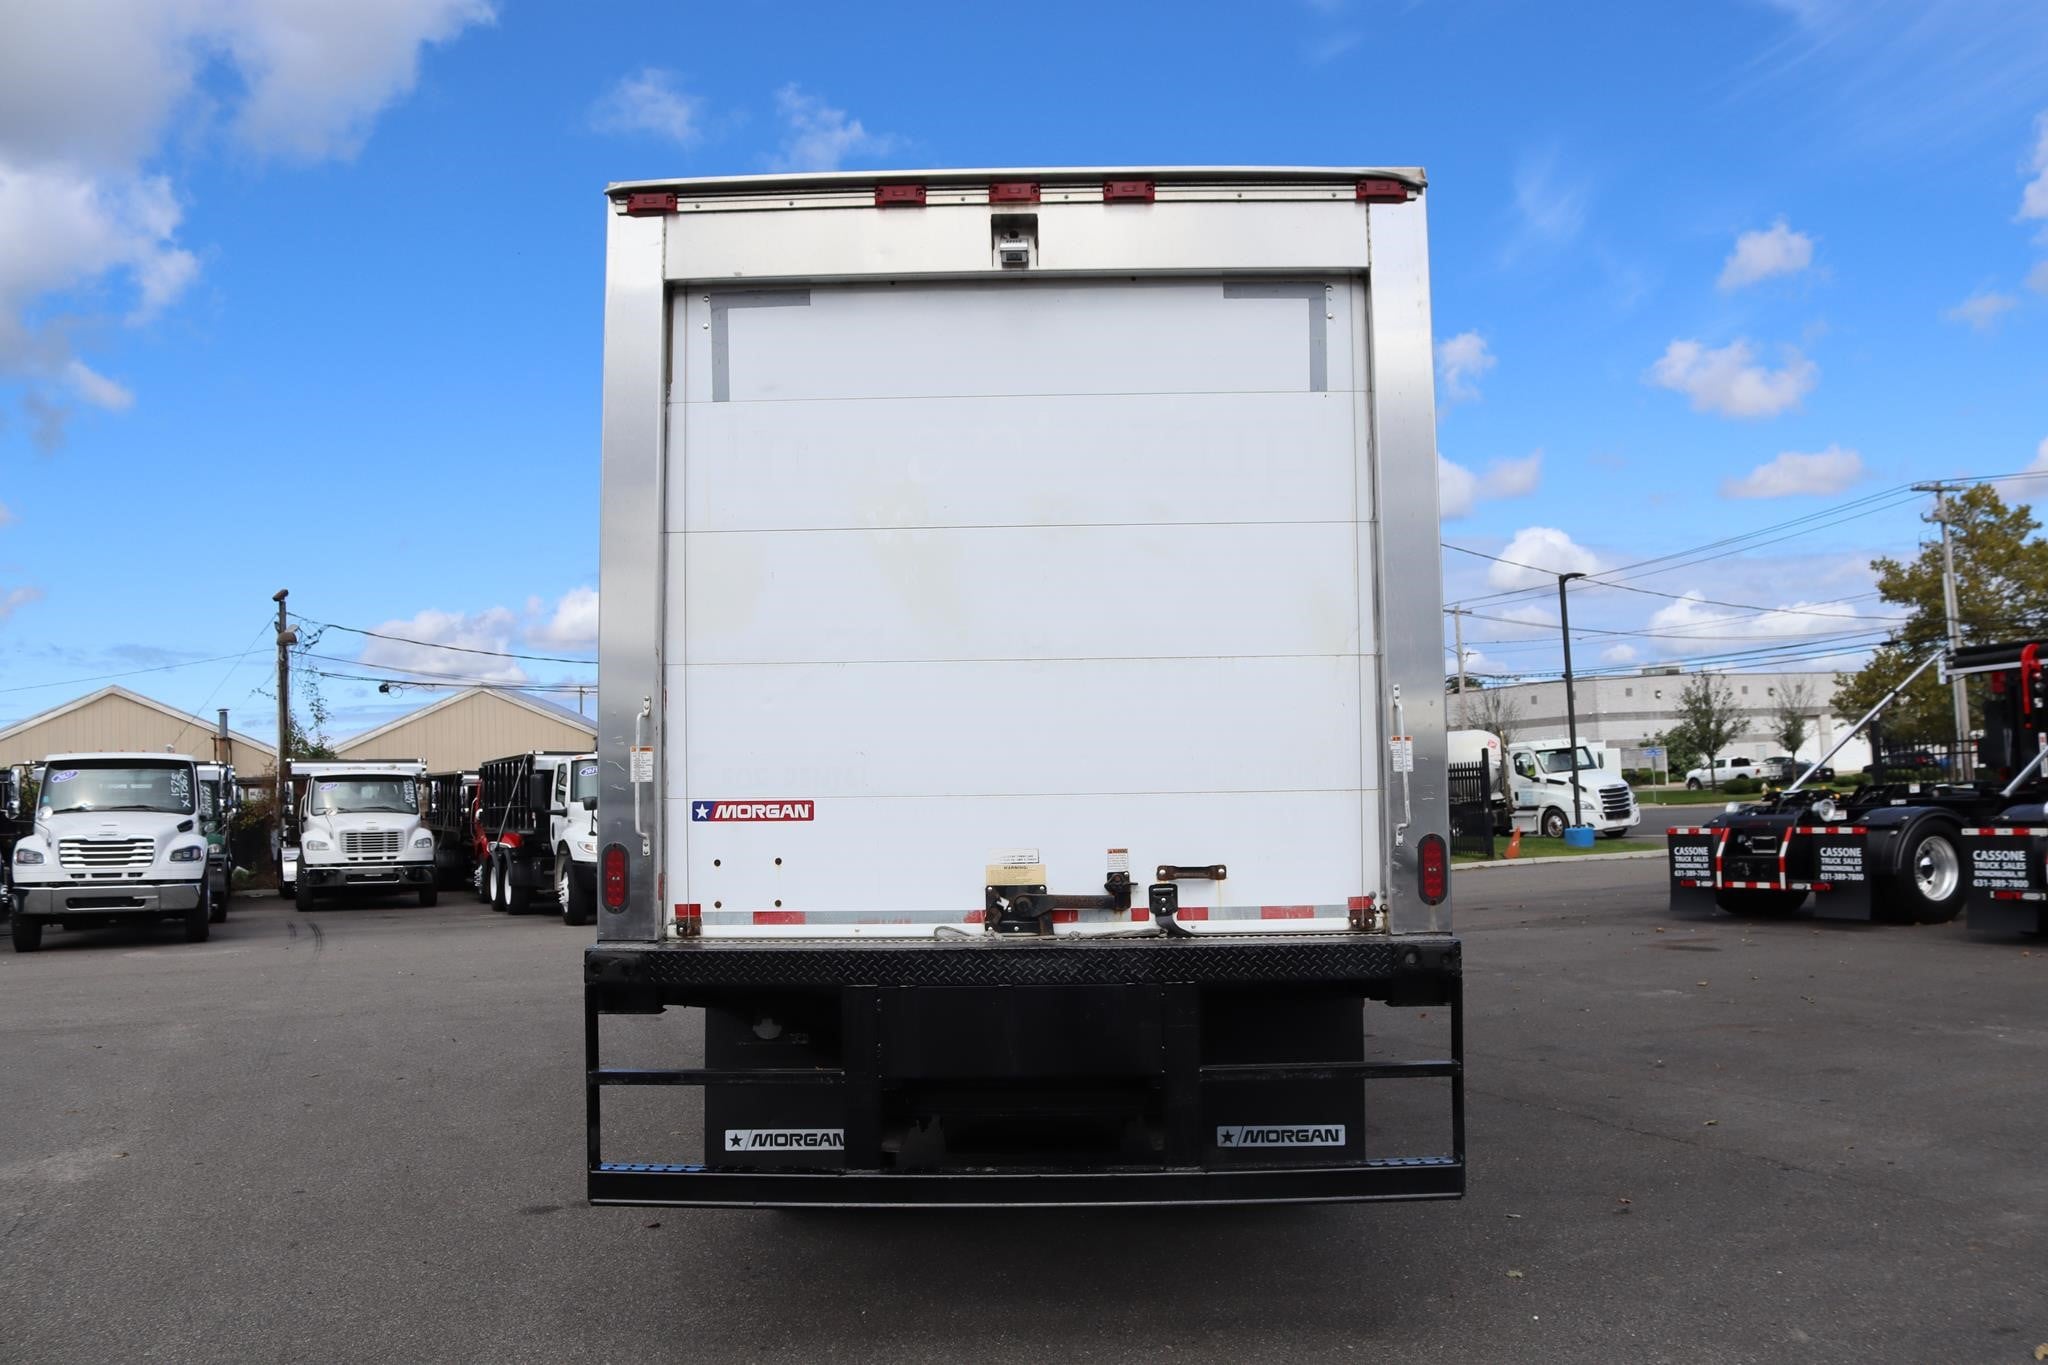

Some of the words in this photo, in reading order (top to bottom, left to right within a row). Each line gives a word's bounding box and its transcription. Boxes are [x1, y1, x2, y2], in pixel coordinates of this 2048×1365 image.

[714, 804, 811, 819] MORGAN
[1674, 847, 1709, 855] CASSONE
[1820, 848, 1862, 857] CASSONE
[1972, 850, 2027, 861] CASSONE
[2001, 862, 2027, 870] SALES
[1243, 1129, 1339, 1143] MORGAN
